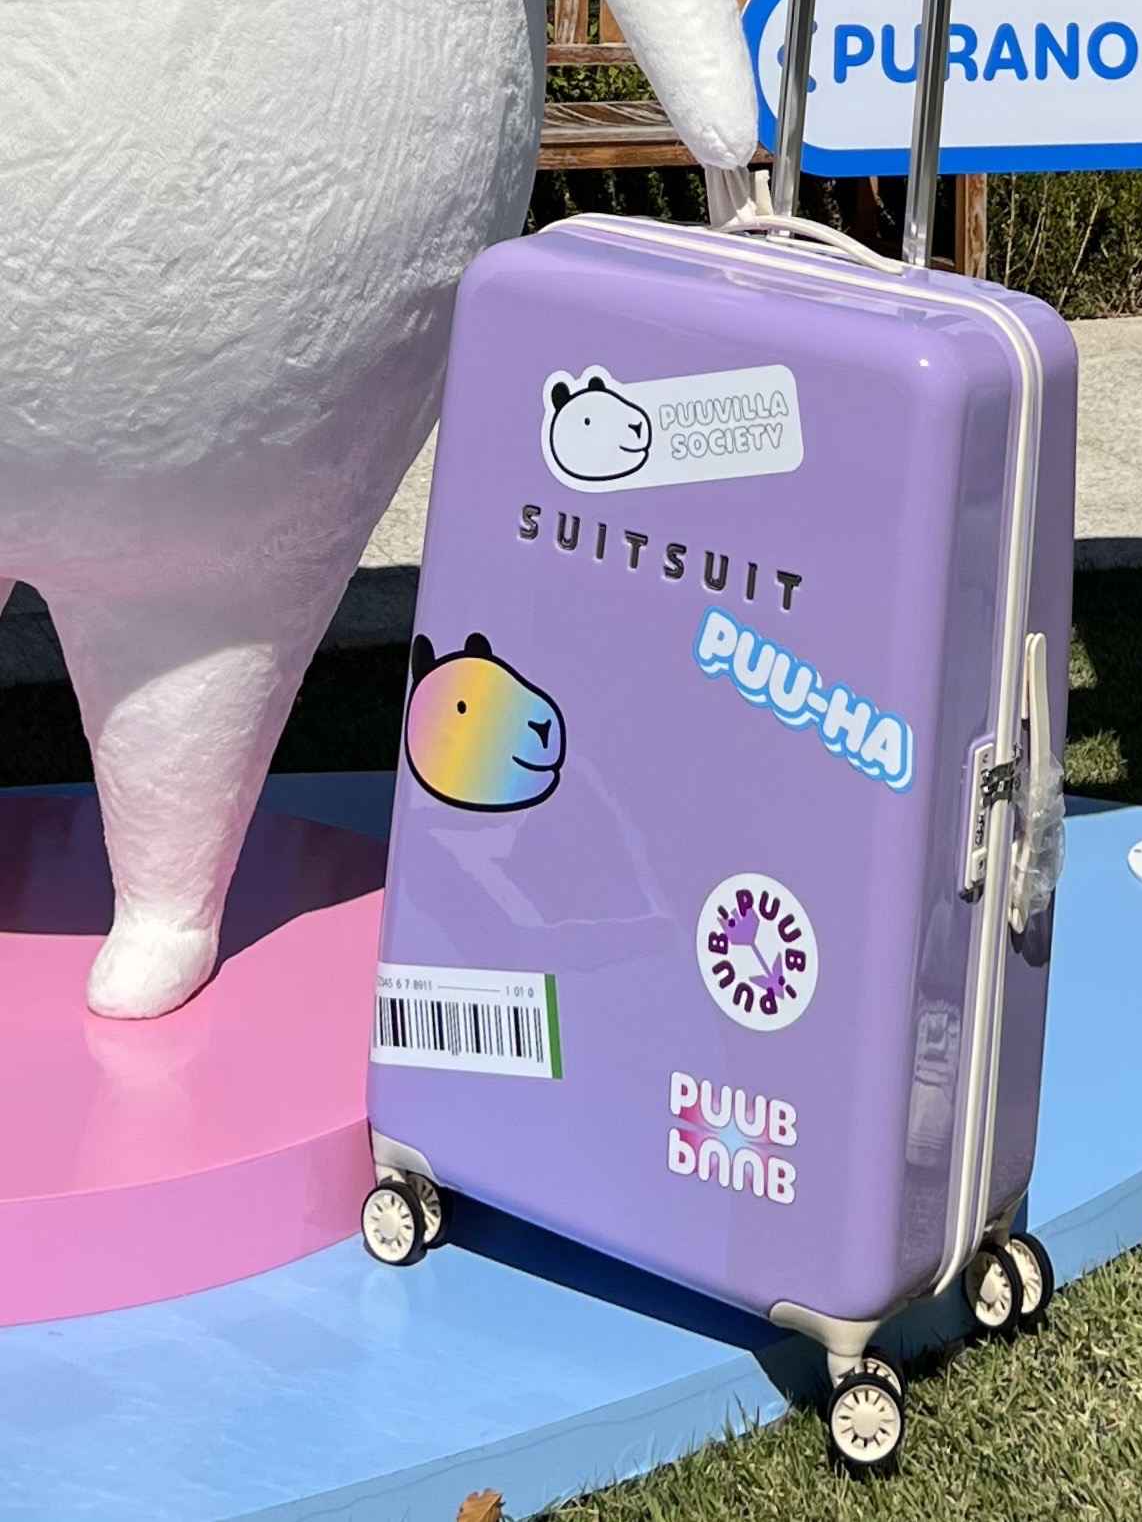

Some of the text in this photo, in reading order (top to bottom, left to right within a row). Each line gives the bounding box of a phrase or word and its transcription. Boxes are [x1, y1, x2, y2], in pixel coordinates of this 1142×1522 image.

[833, 21, 1139, 84] PURANO
[658, 390, 789, 431] PUUVILLA
[670, 422, 783, 460] SOCIETY
[518, 504, 803, 611] SUITSUIT
[697, 609, 908, 782] PUU-HA
[670, 1071, 798, 1147] PUUB
